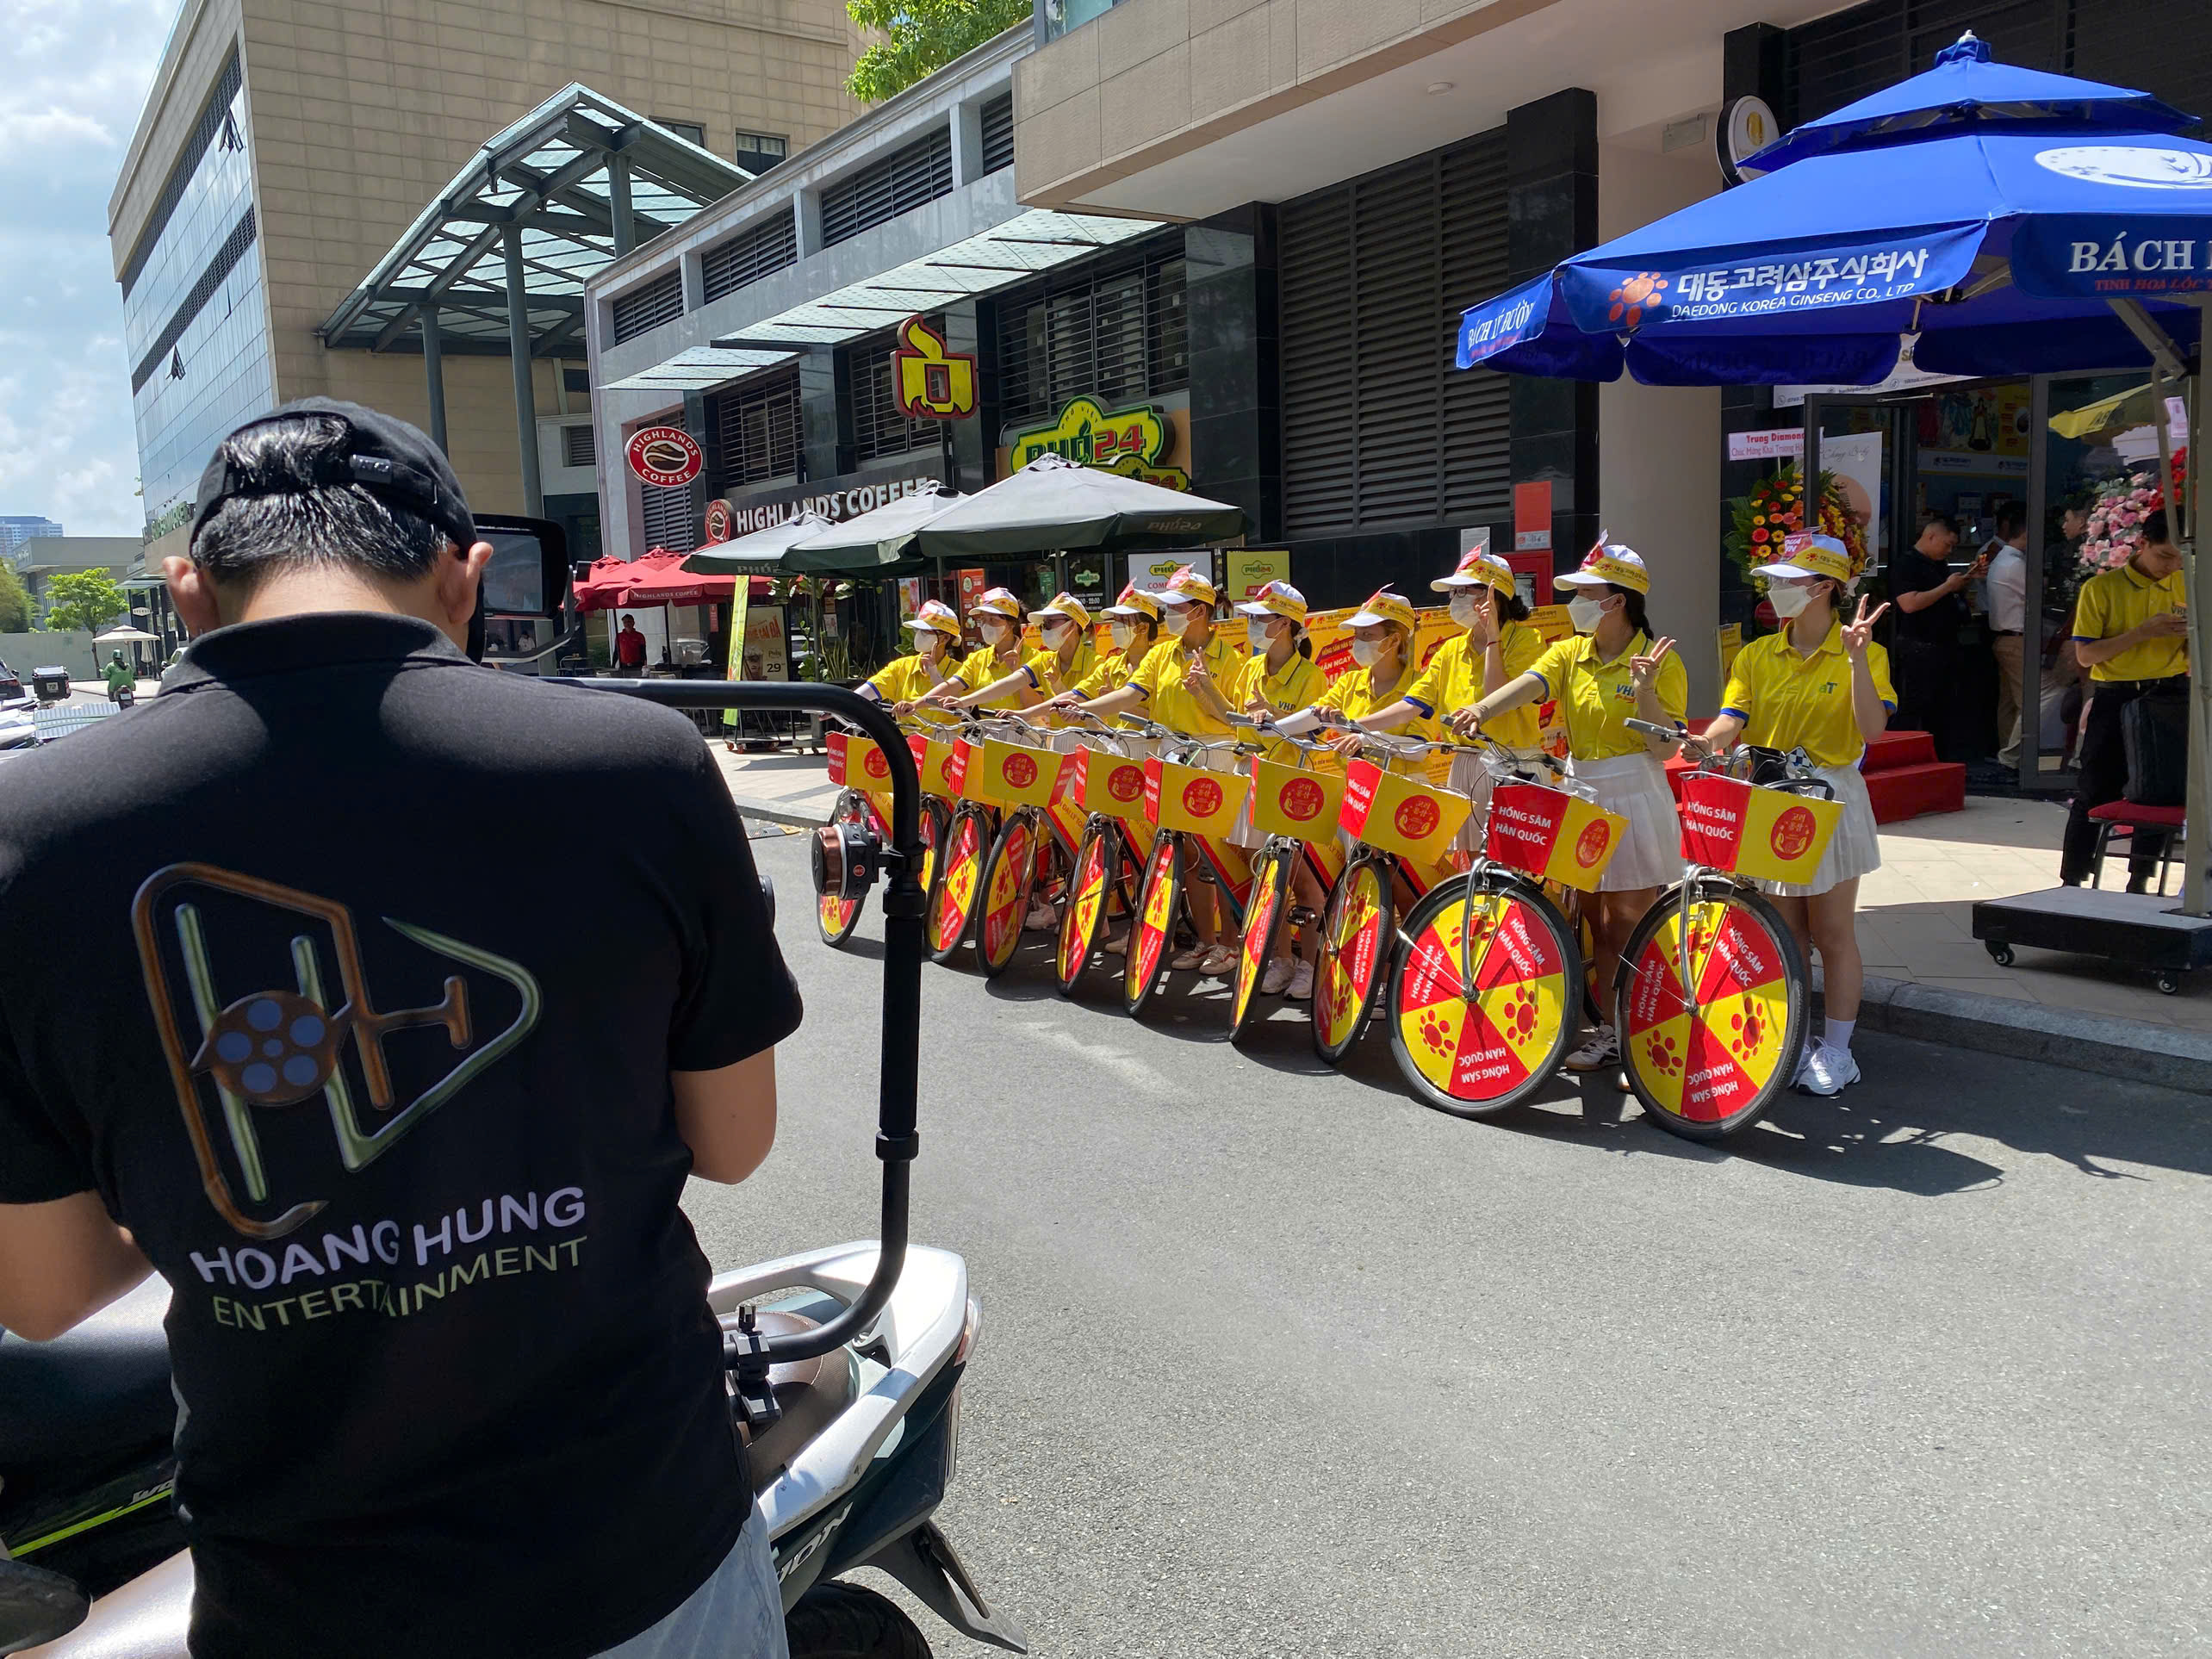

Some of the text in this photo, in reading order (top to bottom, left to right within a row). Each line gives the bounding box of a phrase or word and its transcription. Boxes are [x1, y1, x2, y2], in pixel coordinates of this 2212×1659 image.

[2068, 231, 2196, 272] BÁCH
[1677, 248, 1929, 301] 대동고려삼주식회사
[1672, 302, 1737, 319] DAEDONG
[1740, 296, 1786, 313] KOREA
[1791, 289, 1853, 307] GINSENG
[1886, 283, 1916, 297] LTD
[633, 430, 699, 457] HIGHLANDS
[1746, 434, 1768, 444] Trung
[641, 469, 692, 484] COFFEE
[736, 494, 842, 534] HIGHLANDS
[767, 662, 781, 673] 29
[1499, 805, 1551, 829] HỒNG SÂM
[1687, 801, 1737, 823] HỒNG SÂM
[1494, 823, 1548, 846] HÀN QUỐC
[1686, 820, 1734, 841] HÀN QUỐC
[190, 1186, 587, 1289] HOANG HUNG
[214, 1236, 587, 1331] ENTERTAINMENT
